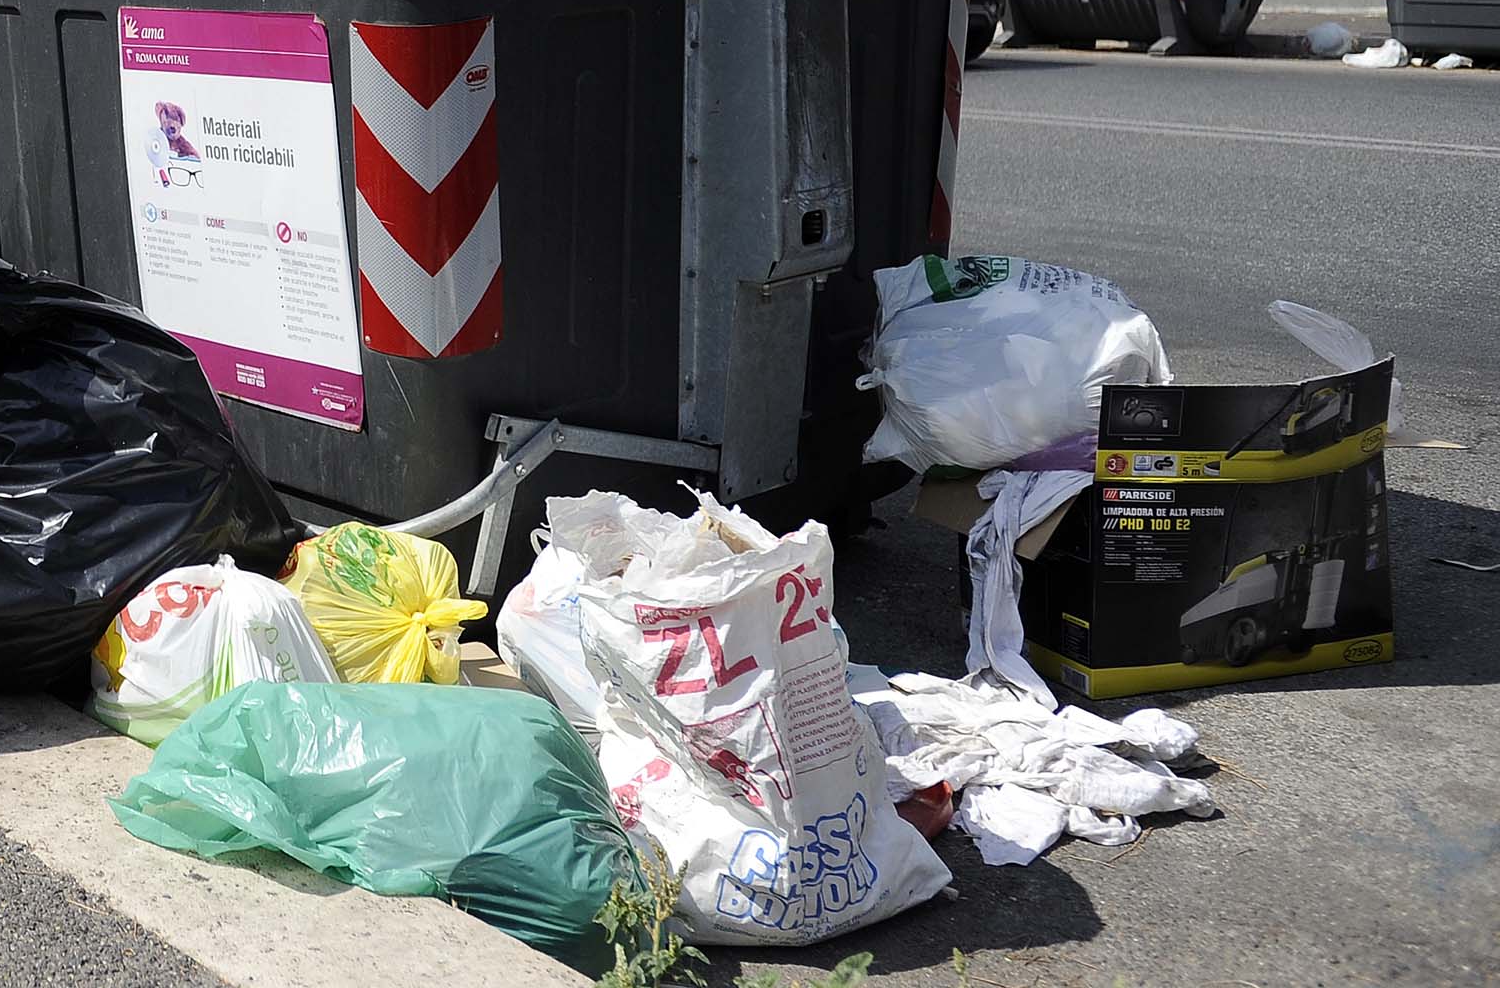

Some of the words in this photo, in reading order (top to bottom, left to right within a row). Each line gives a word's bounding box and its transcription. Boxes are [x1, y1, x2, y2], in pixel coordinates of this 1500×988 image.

[141, 27, 164, 40] ama
[135, 53, 158, 64] ROMA
[157, 55, 190, 66] CAPITALE
[203, 116, 261, 139] Materiali
[205, 144, 229, 161] non
[233, 144, 295, 168] riciclabili
[206, 217, 226, 229] COME
[297, 231, 307, 242] NO
[1108, 458, 1116, 470] 3
[1182, 467, 1189, 476] 5
[1119, 490, 1172, 500] PARKSIDE
[1103, 507, 1153, 516] LIMPIADORA
[1156, 508, 1166, 517] DE
[1169, 508, 1188, 517] ALTA
[1191, 506, 1224, 517] PRESIÓN
[1119, 518, 1144, 530] PHD
[1150, 518, 1171, 530] 100
[1176, 519, 1191, 530] E2
[643, 615, 759, 697] ZL
